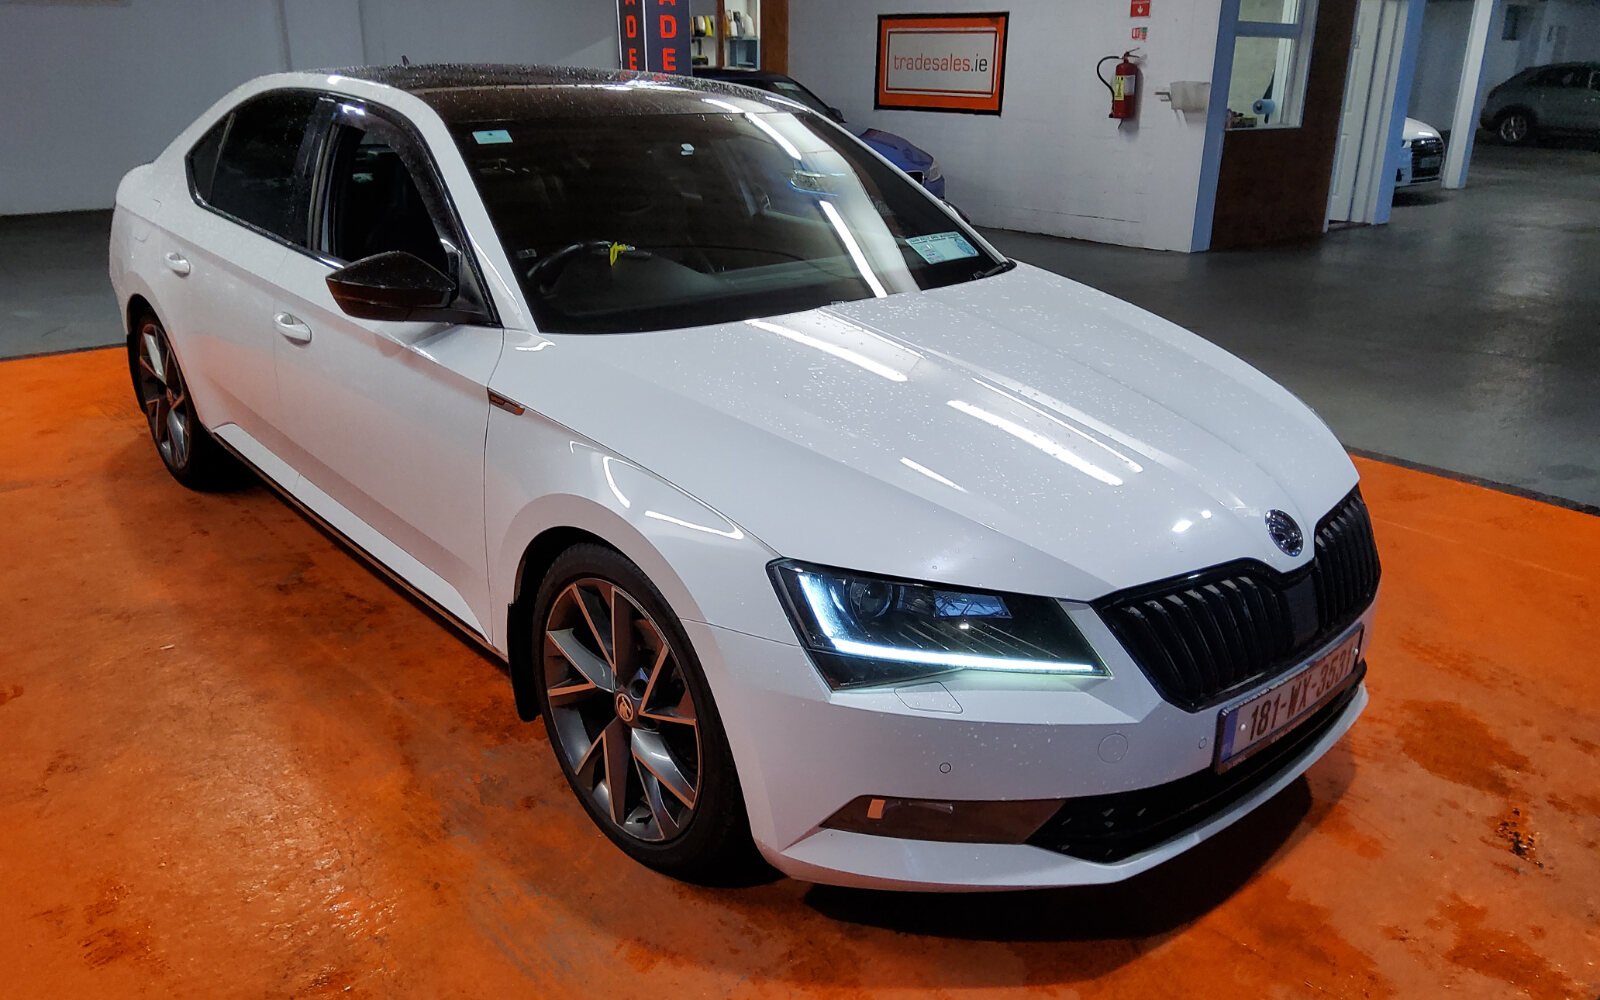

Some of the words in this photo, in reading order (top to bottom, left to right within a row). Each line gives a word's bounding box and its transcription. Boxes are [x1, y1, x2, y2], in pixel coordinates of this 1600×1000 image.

[658, 0, 677, 71] DE
[893, 53, 988, 72] tradesales.ie
[1250, 642, 1353, 741] 181-WX-3531
